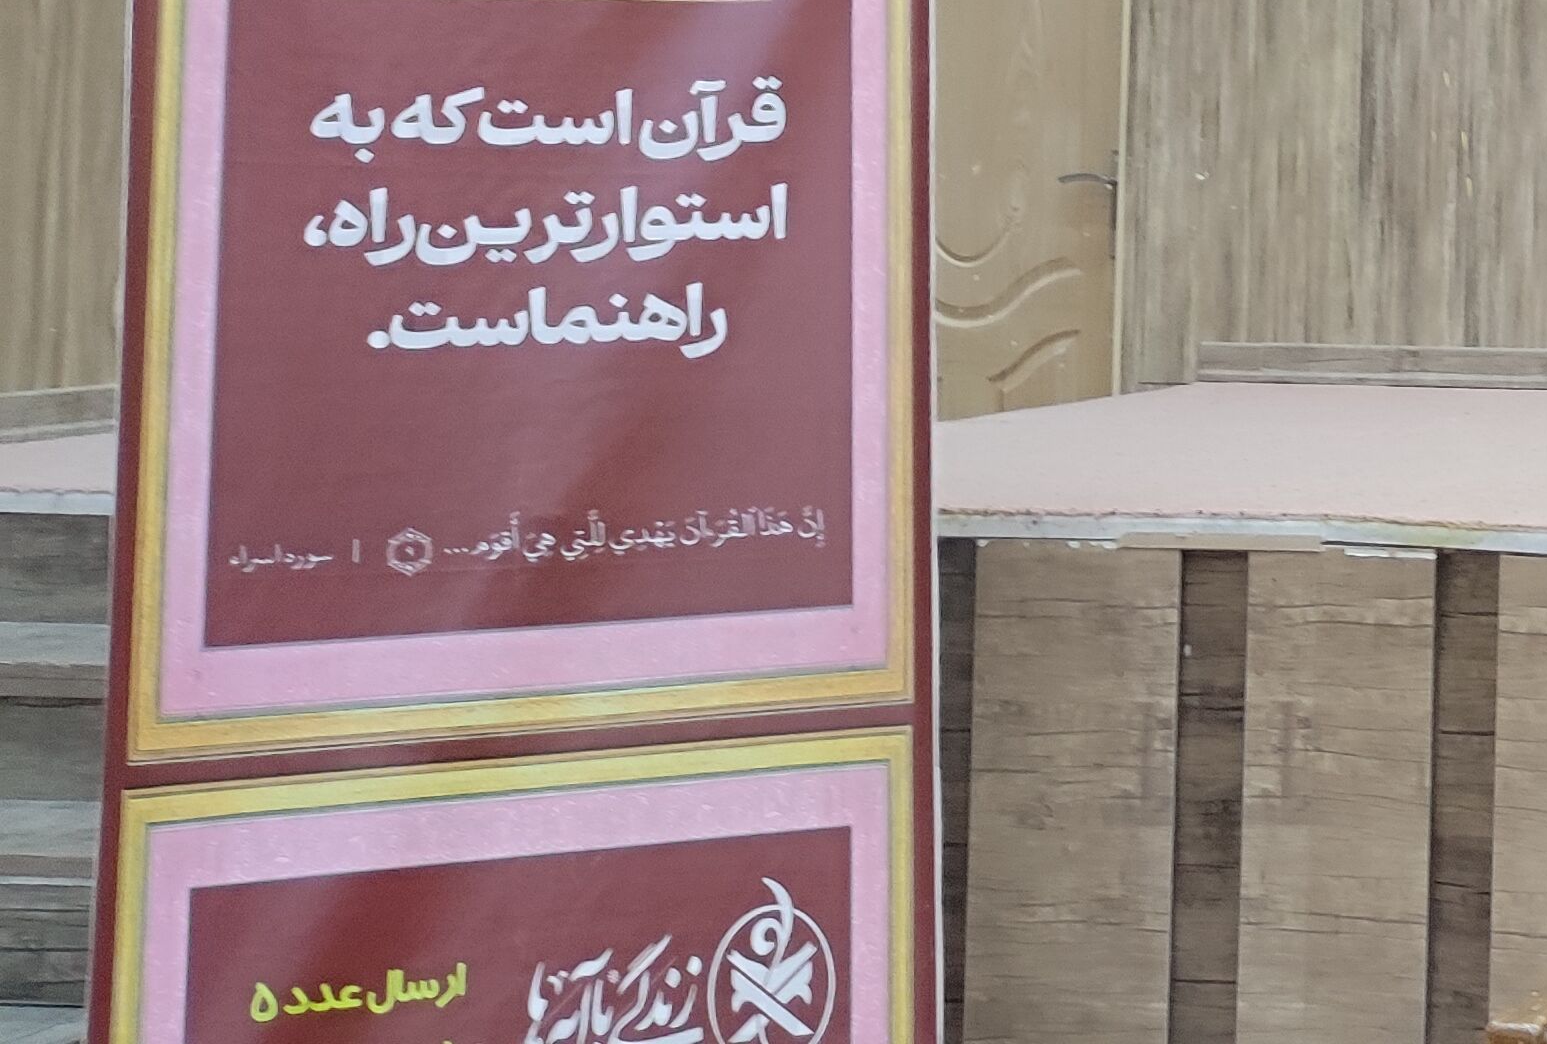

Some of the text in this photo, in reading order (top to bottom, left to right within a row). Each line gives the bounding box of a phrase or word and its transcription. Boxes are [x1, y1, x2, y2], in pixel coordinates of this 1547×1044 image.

[309, 74, 788, 164] قرآن است که به
[303, 182, 788, 267] استوارترین راه،
[366, 281, 729, 360] راهنماست.
[250, 962, 467, 1023] ارسال عدد ۵
